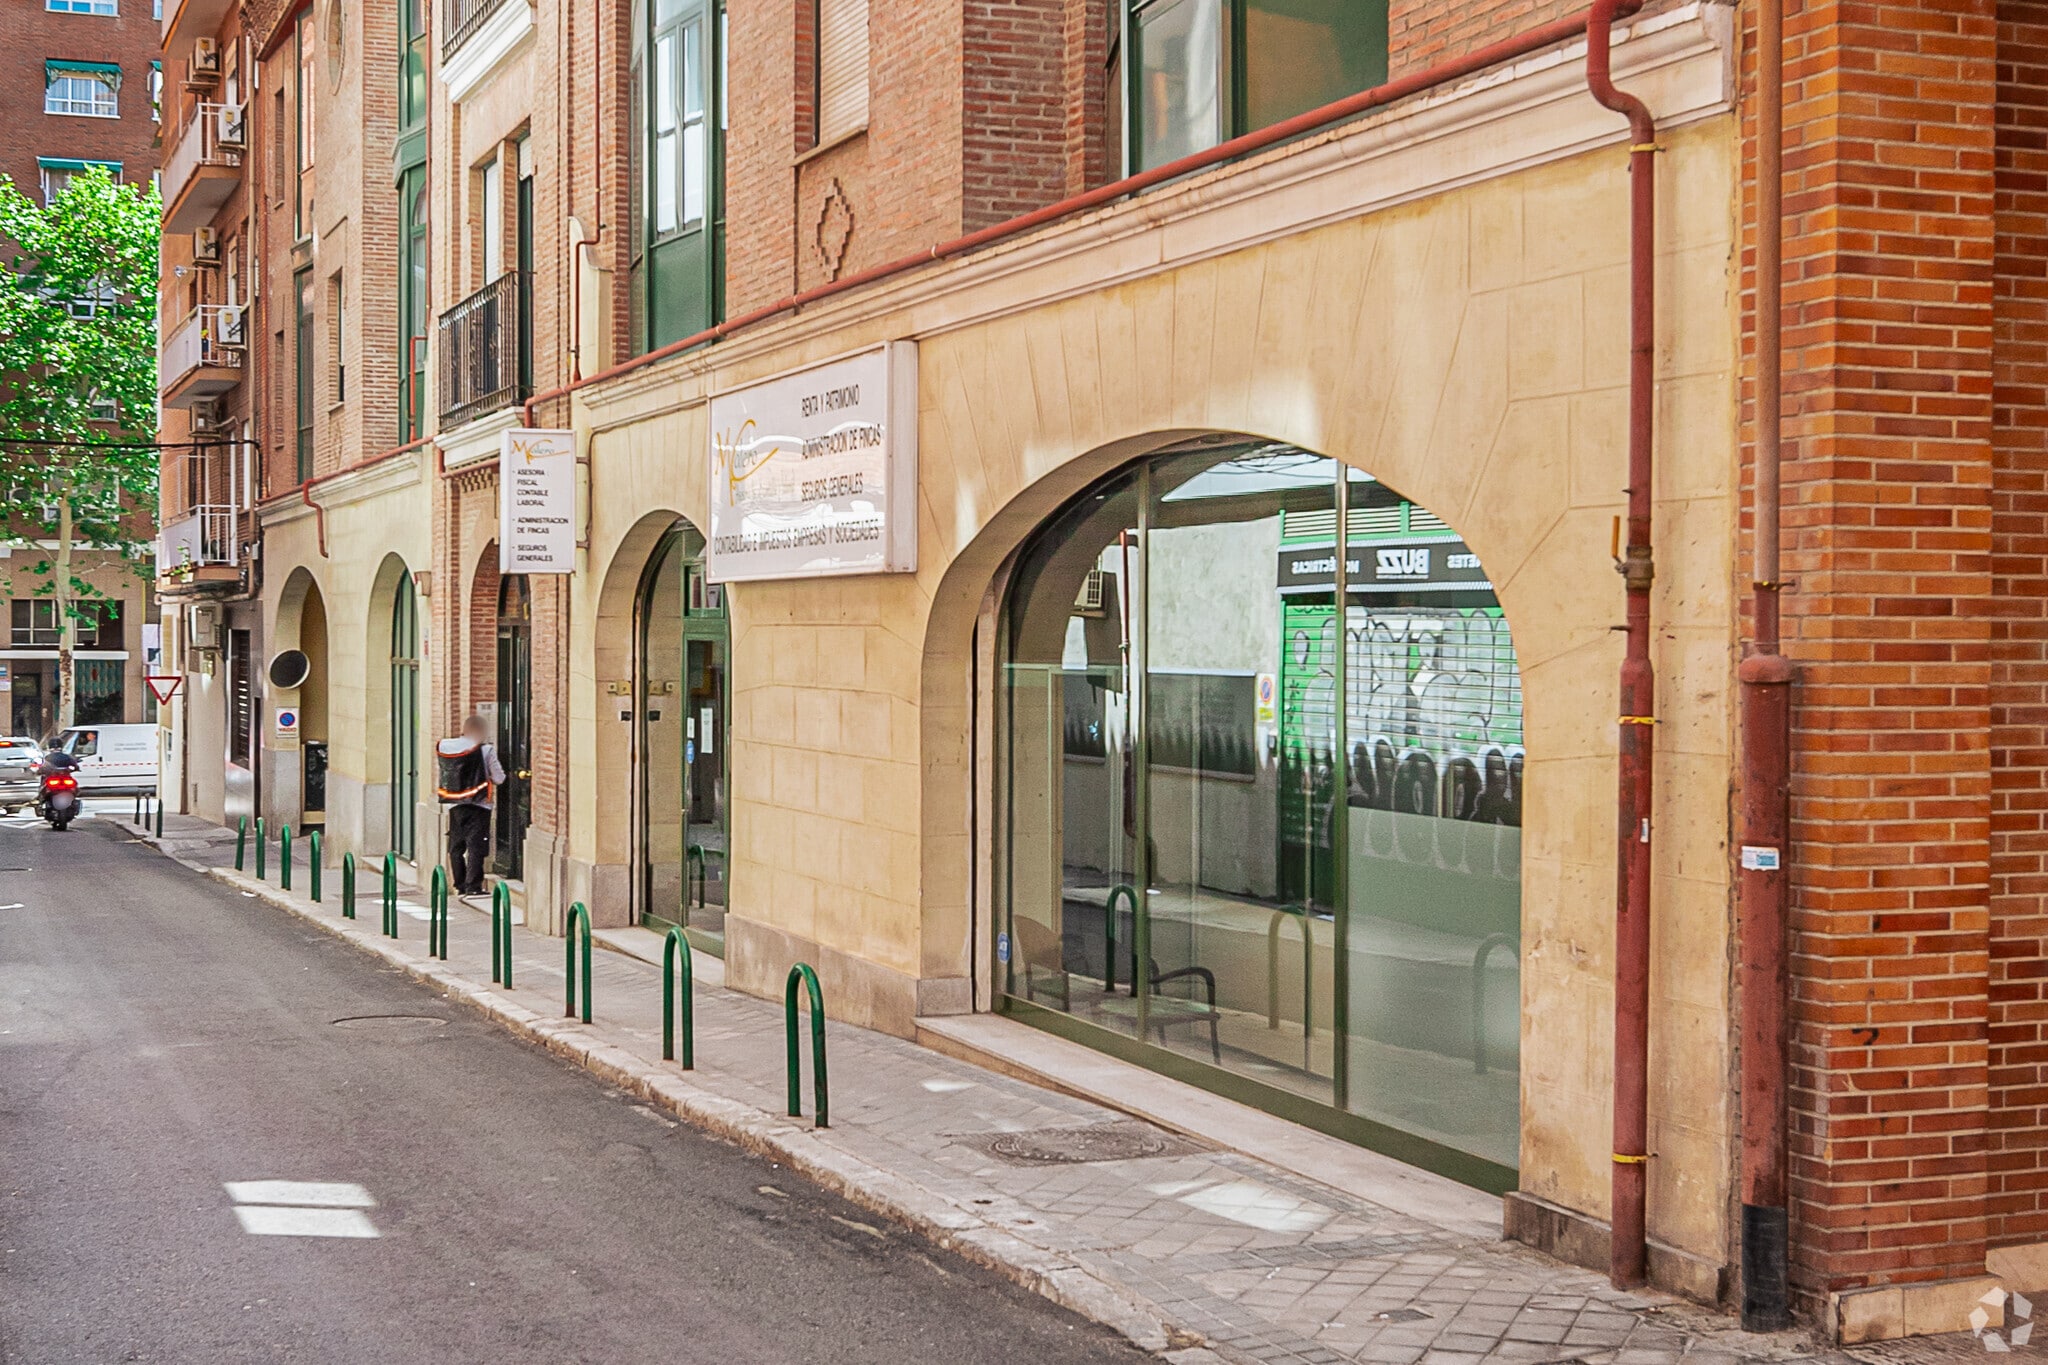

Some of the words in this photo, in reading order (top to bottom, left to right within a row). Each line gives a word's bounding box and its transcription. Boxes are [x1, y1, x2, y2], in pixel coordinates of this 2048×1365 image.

[802, 395, 818, 418] RENTA
[825, 384, 860, 412] PATRIMONIO
[849, 428, 857, 450] DE
[860, 423, 881, 449] FINCAS
[802, 478, 827, 502] SEGUROS
[829, 472, 863, 498] GENERALES
[835, 518, 879, 543] SOCIEDADES
